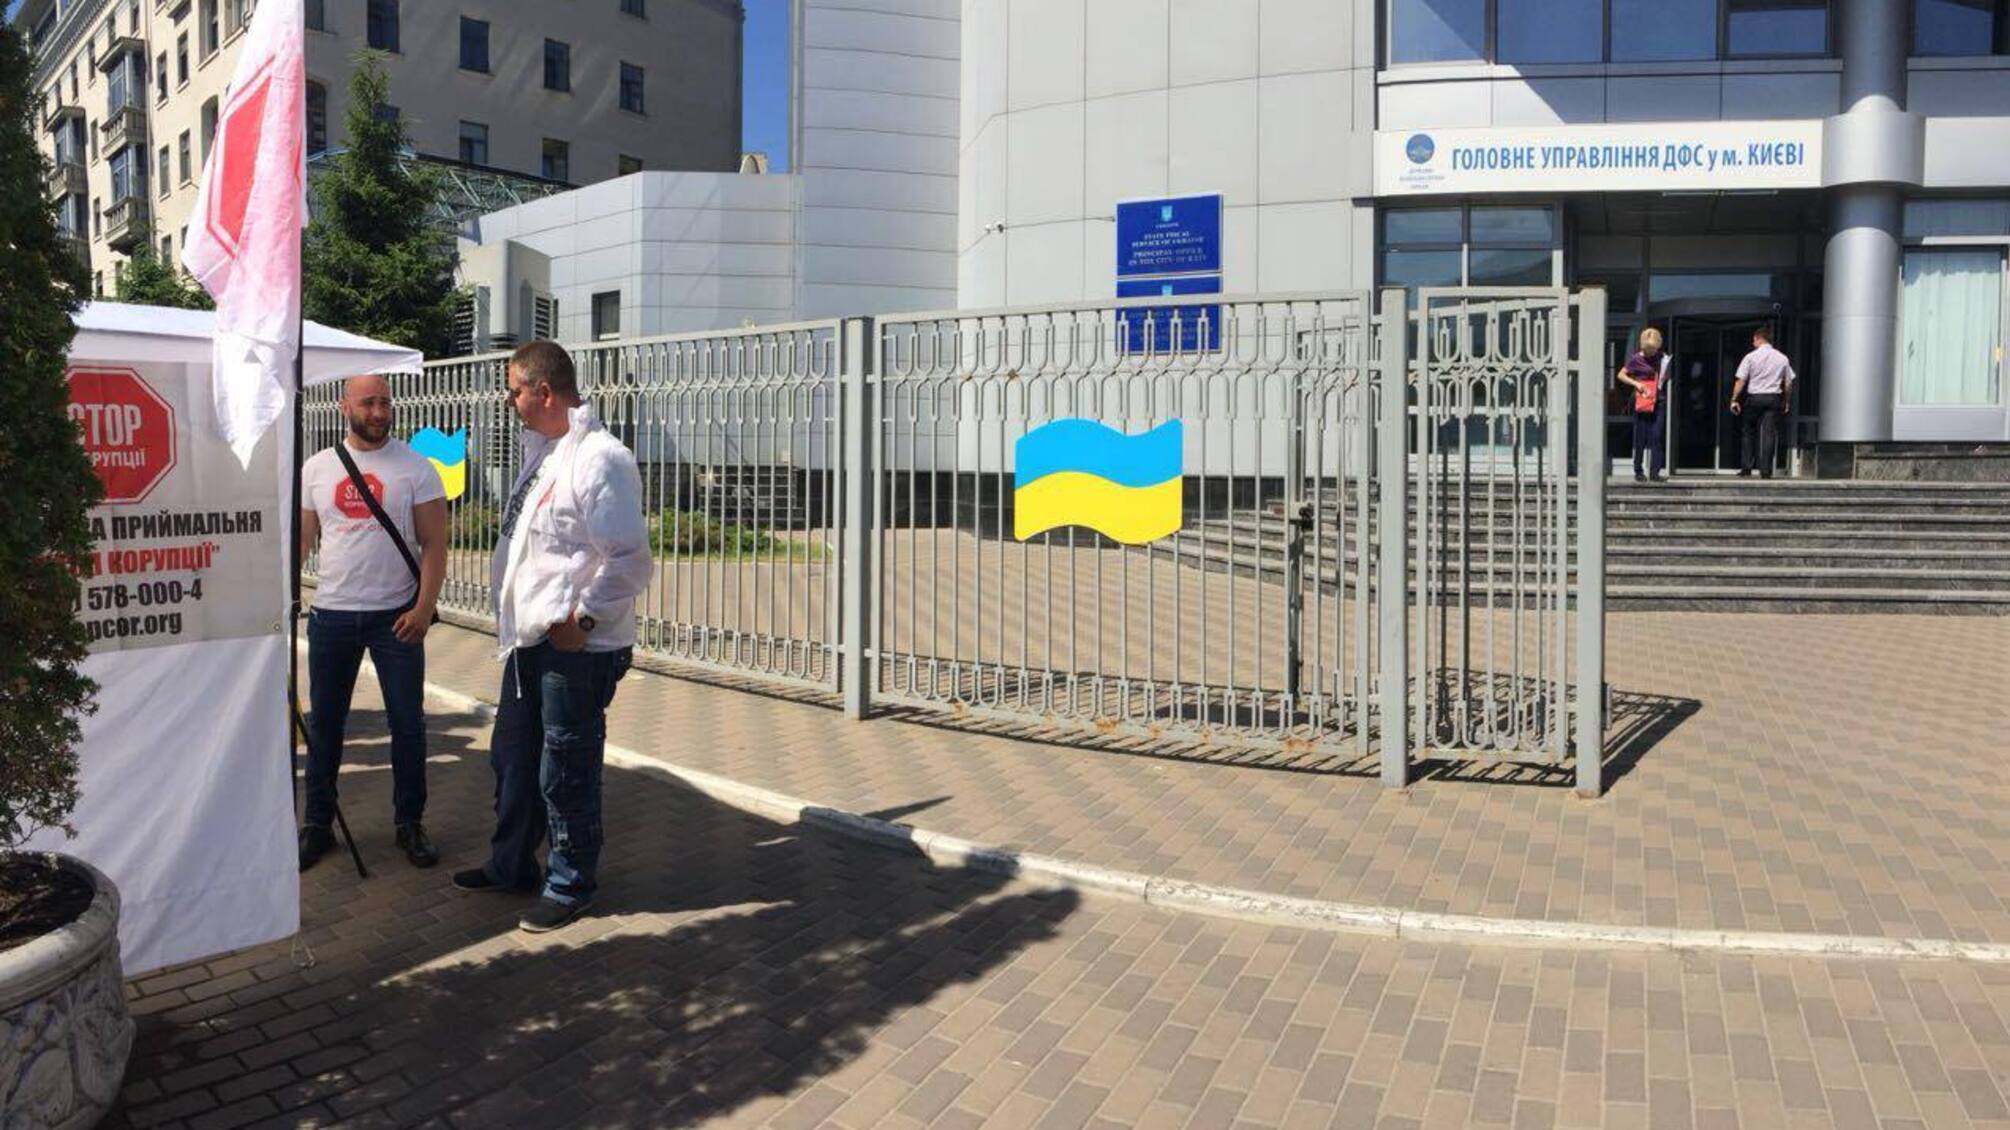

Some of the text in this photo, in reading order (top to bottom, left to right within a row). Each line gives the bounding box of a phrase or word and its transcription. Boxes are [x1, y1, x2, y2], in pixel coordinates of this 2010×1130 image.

[1452, 147, 1535, 170] ГОЛОВНЕ
[1541, 145, 1659, 169] УПРАВЛІННЯ
[1662, 144, 1704, 171] ДФС
[1722, 149, 1743, 167] м.
[1749, 143, 1804, 166] КИЄВІ
[84, 448, 146, 470] РУПЦІЇ
[112, 509, 262, 540] ПРИЙМАЛЬНЯ
[88, 578, 203, 611] 578-000-4
[84, 612, 182, 641] pcor.org
